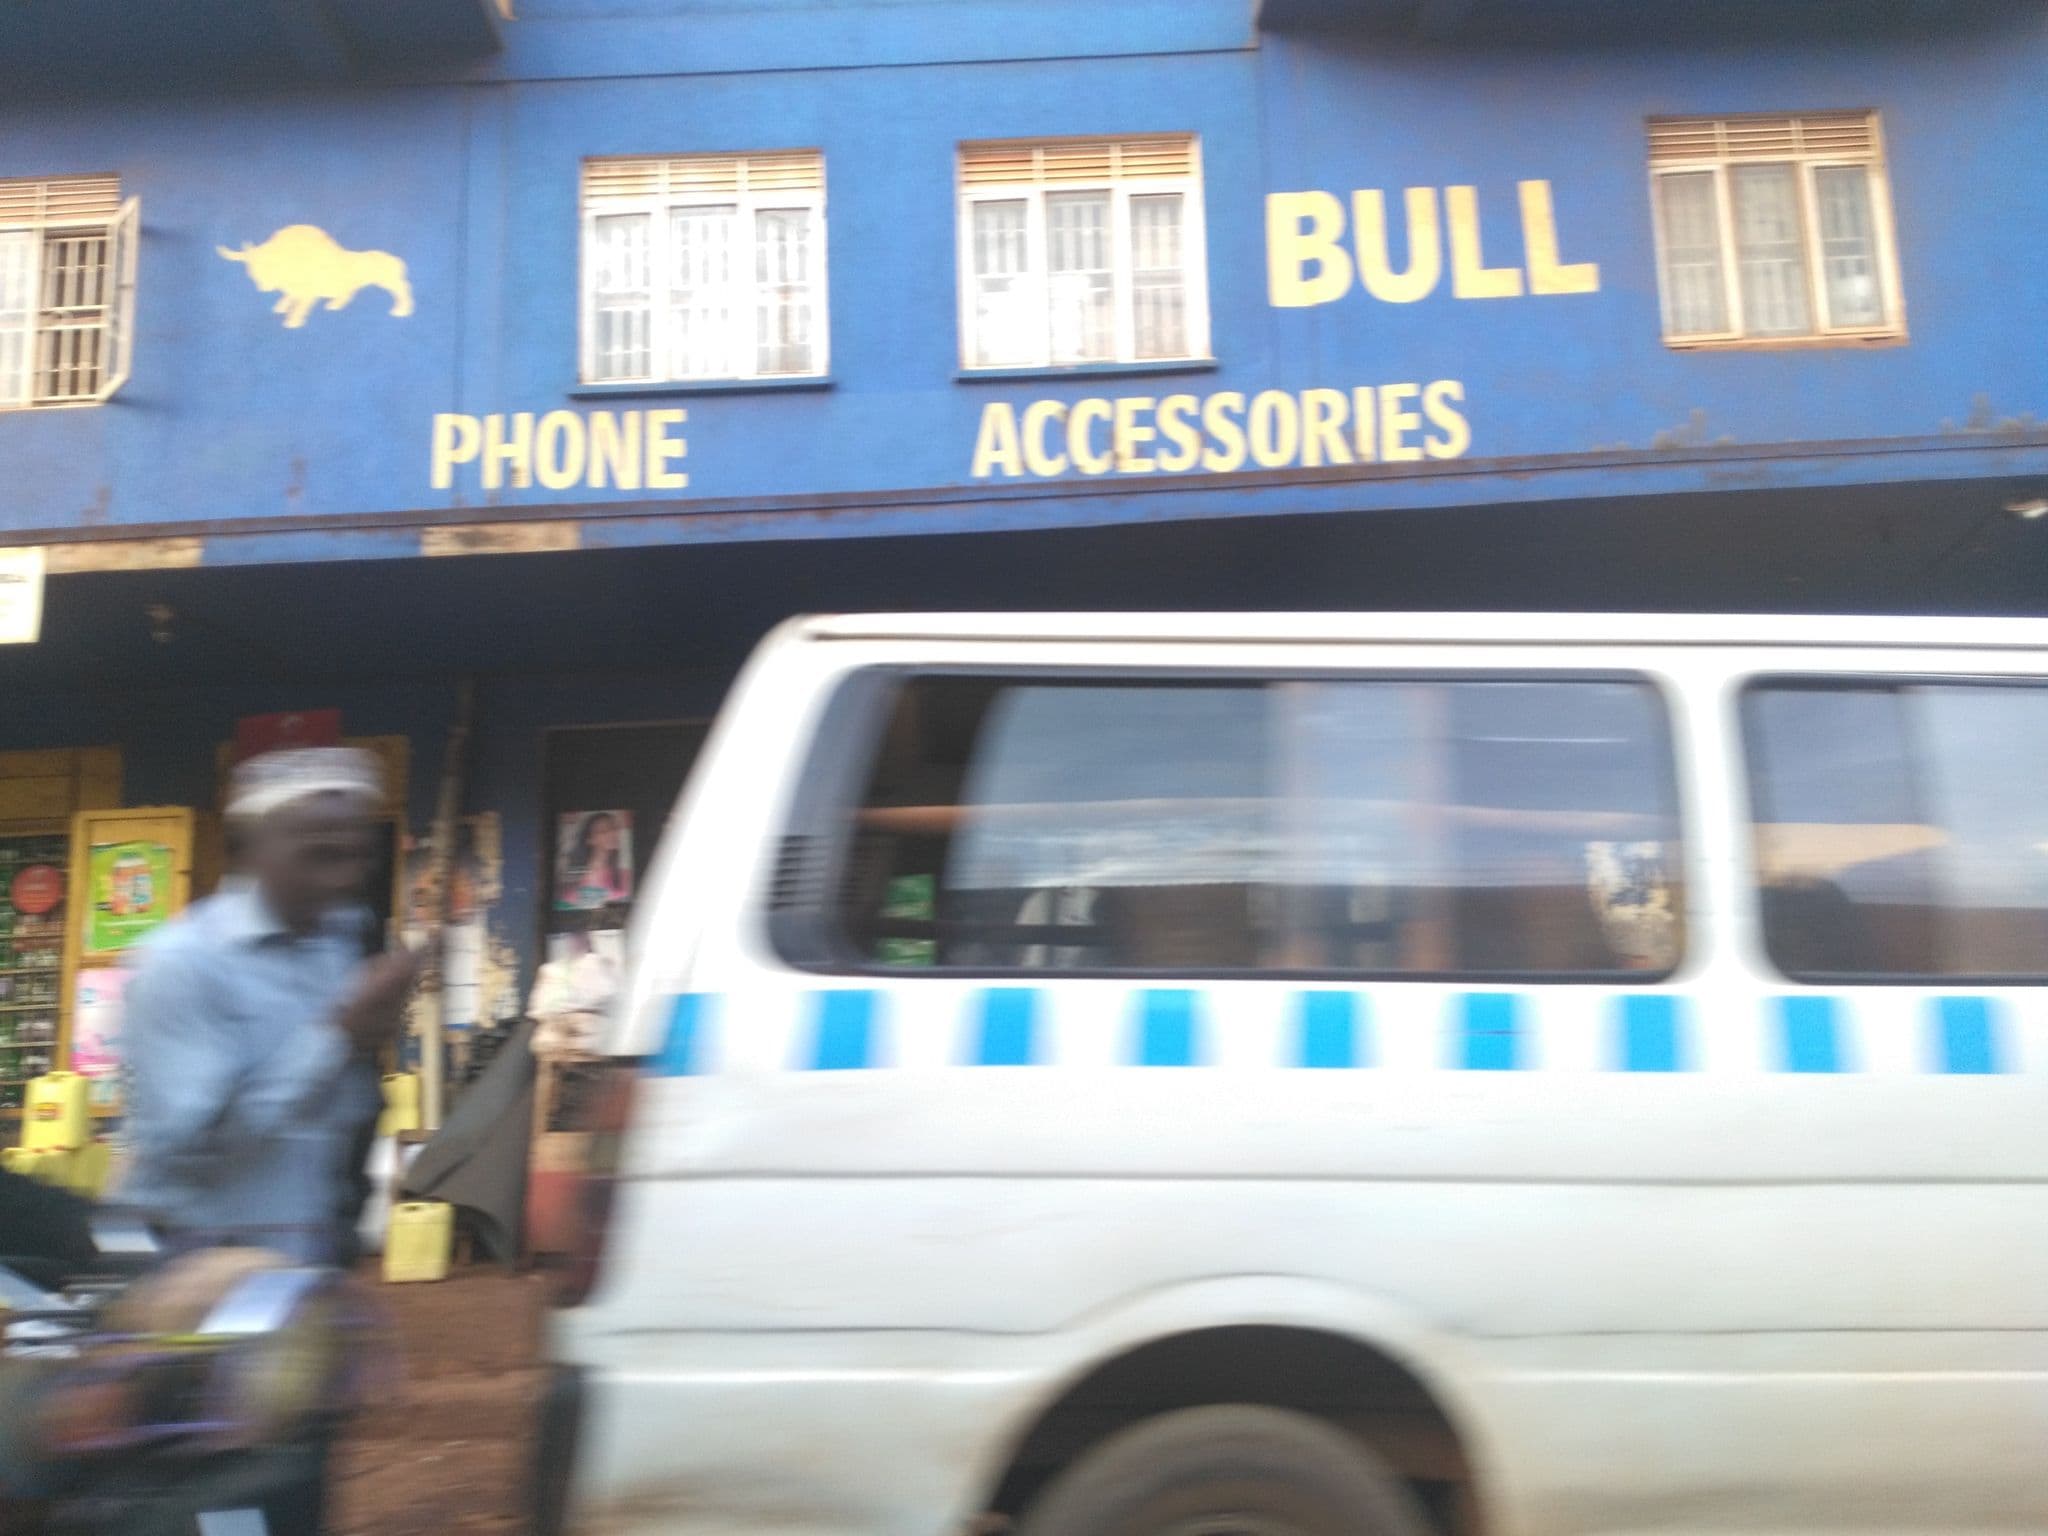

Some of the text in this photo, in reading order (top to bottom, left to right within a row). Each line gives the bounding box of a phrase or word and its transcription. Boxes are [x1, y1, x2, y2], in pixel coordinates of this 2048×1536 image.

[1265, 179, 1599, 308] BULL
[430, 379, 1472, 490] PHONE ACCESSORIES
